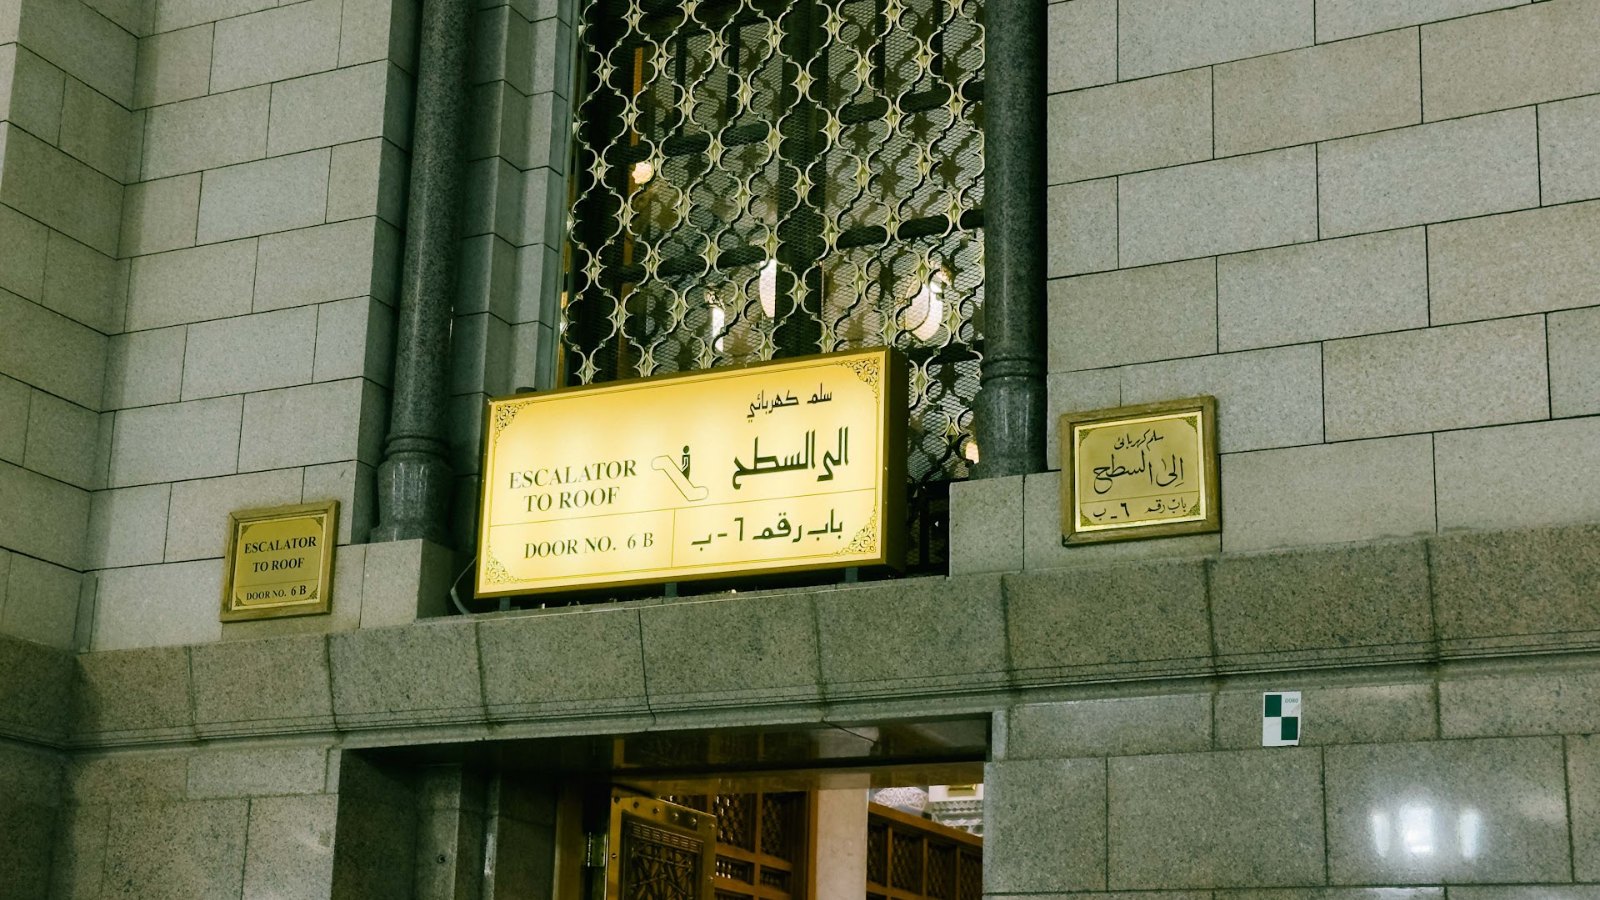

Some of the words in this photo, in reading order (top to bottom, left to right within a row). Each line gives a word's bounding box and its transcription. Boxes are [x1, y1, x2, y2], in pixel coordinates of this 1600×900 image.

[747, 389, 799, 423] كهربائي
[807, 382, 832, 404] سلم
[732, 429, 815, 490] السطح
[1093, 450, 1153, 495] السطح
[509, 459, 637, 489] ESCALATOR
[524, 494, 552, 512] TO
[559, 487, 619, 509] ROOF
[752, 512, 802, 543] رقم
[807, 508, 843, 541] باب
[244, 536, 317, 554] ESCALATOR
[525, 539, 578, 558] DOOR
[584, 536, 616, 553] NO.
[627, 534, 636, 550] 6
[643, 532, 654, 548] B
[253, 561, 268, 573] TO
[271, 557, 305, 571] ROOF
[246, 592, 270, 601] DOOR
[273, 589, 287, 598] NO.
[290, 586, 297, 597] 6
[299, 585, 307, 596] B
